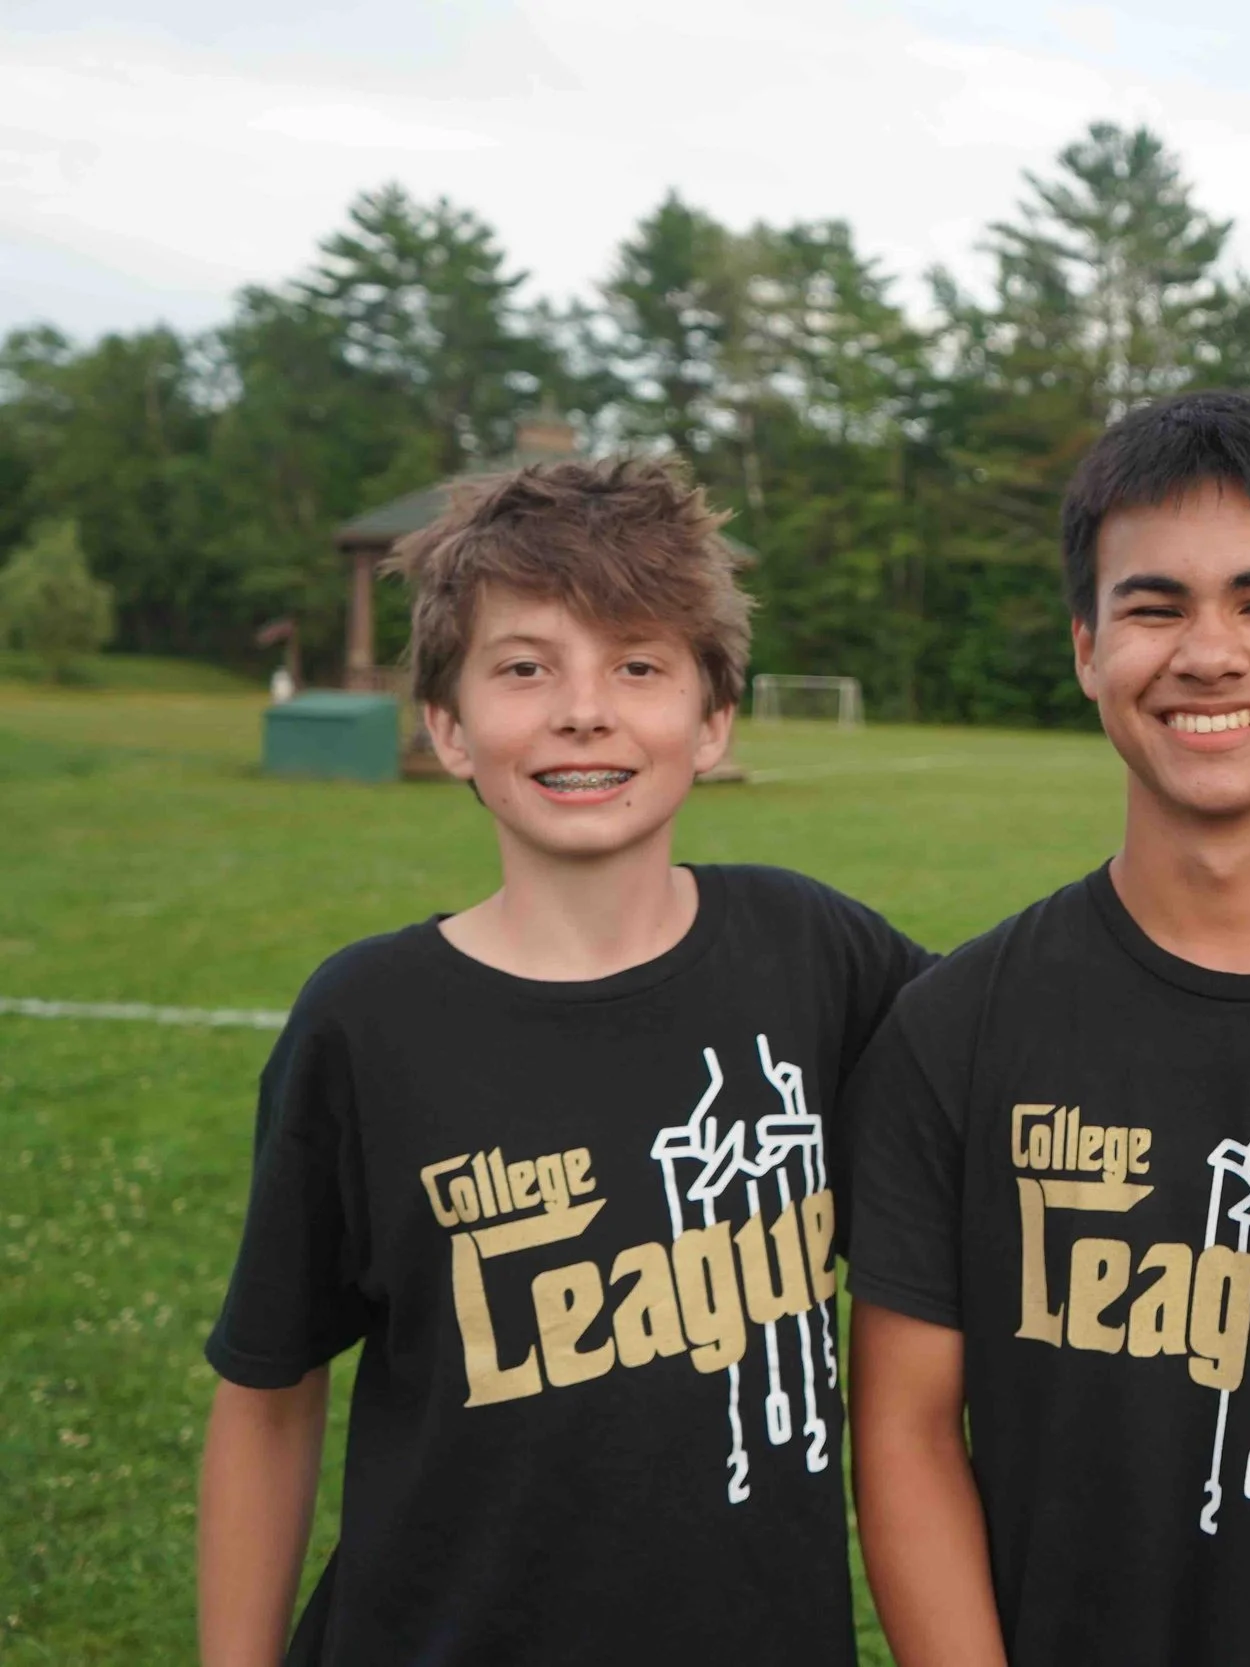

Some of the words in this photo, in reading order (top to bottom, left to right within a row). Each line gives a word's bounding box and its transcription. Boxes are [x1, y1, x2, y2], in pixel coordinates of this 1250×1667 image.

[1011, 1103, 1152, 1182] College
[420, 1146, 597, 1228] College
[450, 1188, 836, 1408] League
